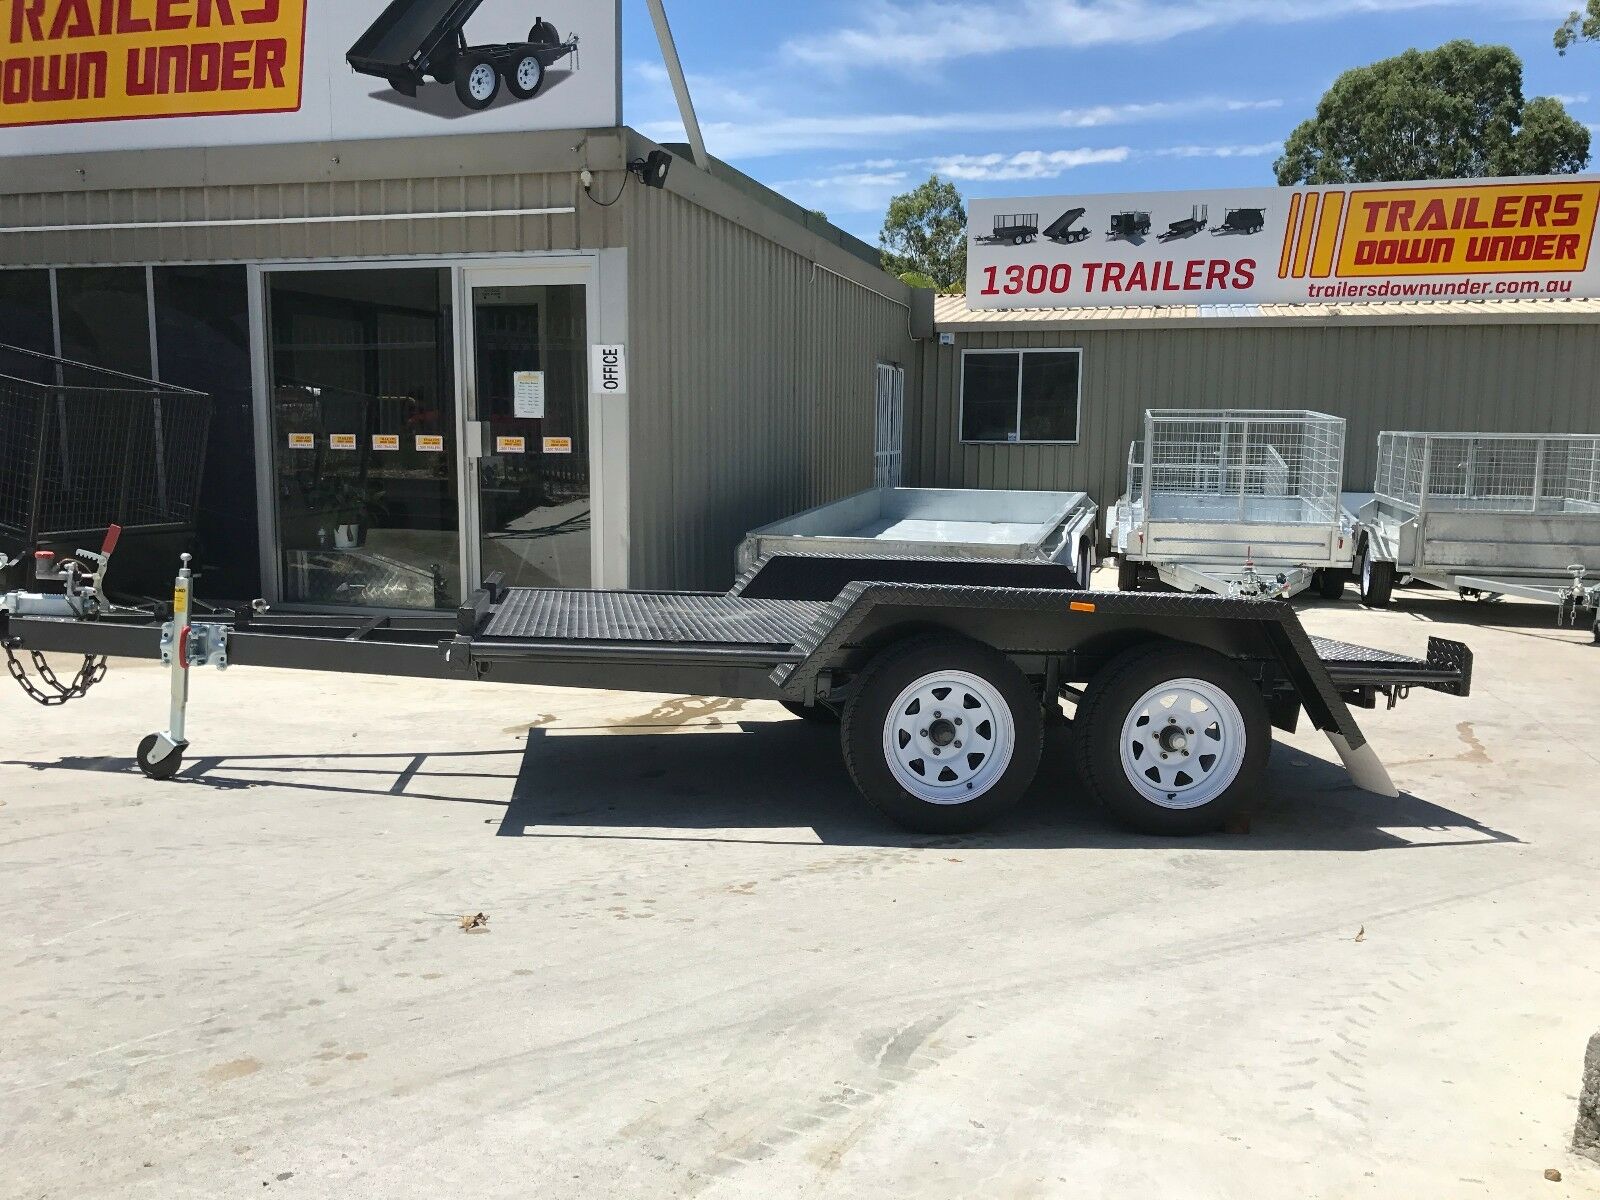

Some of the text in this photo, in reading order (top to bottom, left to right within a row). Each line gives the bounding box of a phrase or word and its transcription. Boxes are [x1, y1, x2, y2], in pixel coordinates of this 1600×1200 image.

[0, 0, 280, 44] RAILE
[0, 38, 287, 105] OWN UNDER
[1362, 194, 1584, 233] TRAILERS
[1354, 233, 1581, 266] DOWN UNDER
[980, 258, 1257, 295] 1300 TRAILERS
[1308, 279, 1572, 298] trailersdownunder.com.au
[603, 348, 619, 390] OFFICE
